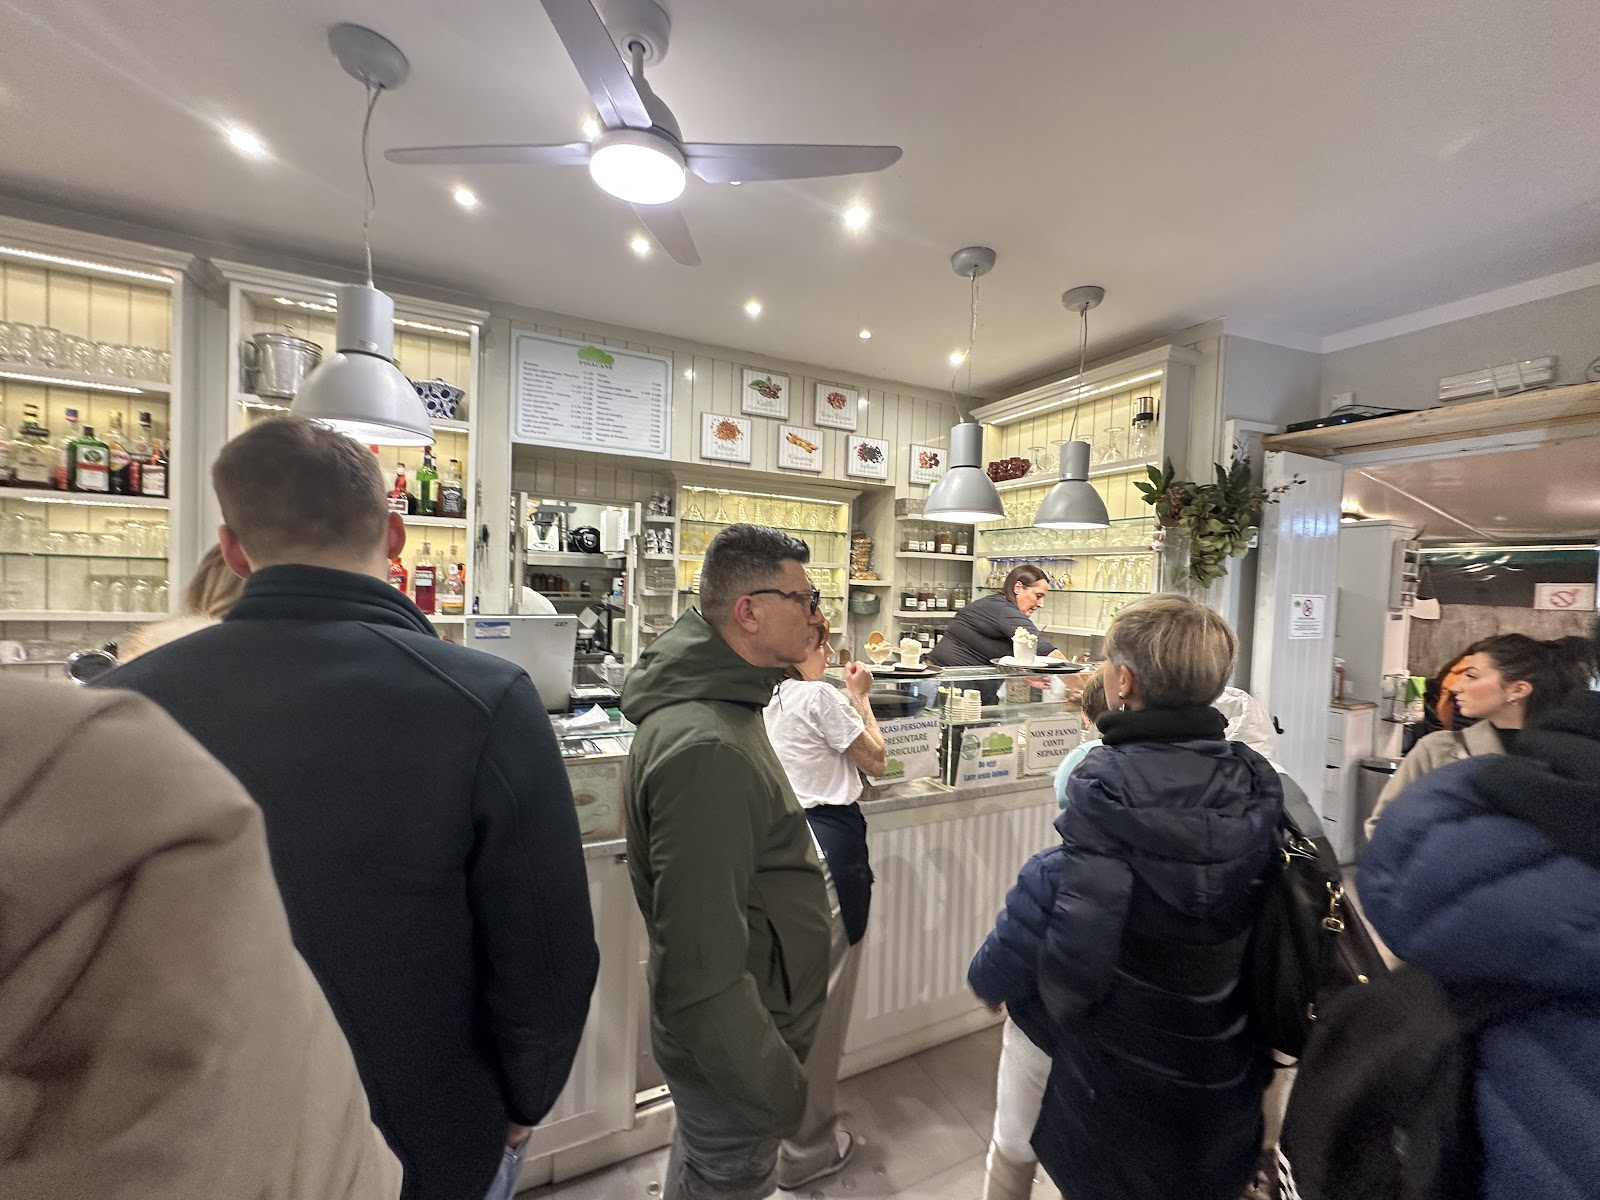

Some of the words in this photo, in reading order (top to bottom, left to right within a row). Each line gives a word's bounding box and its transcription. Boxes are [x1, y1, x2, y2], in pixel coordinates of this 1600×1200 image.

[579, 360, 613, 370] PISACANE
[880, 725, 899, 734] RCASI
[900, 720, 938, 731] PERSONALE
[1030, 729, 1046, 738] NON
[1047, 729, 1054, 738] SI
[1055, 728, 1078, 737] FANNO
[1042, 738, 1065, 748] CONTI
[885, 744, 930, 758] URRICULUM
[1036, 747, 1069, 758] SEPARATI
